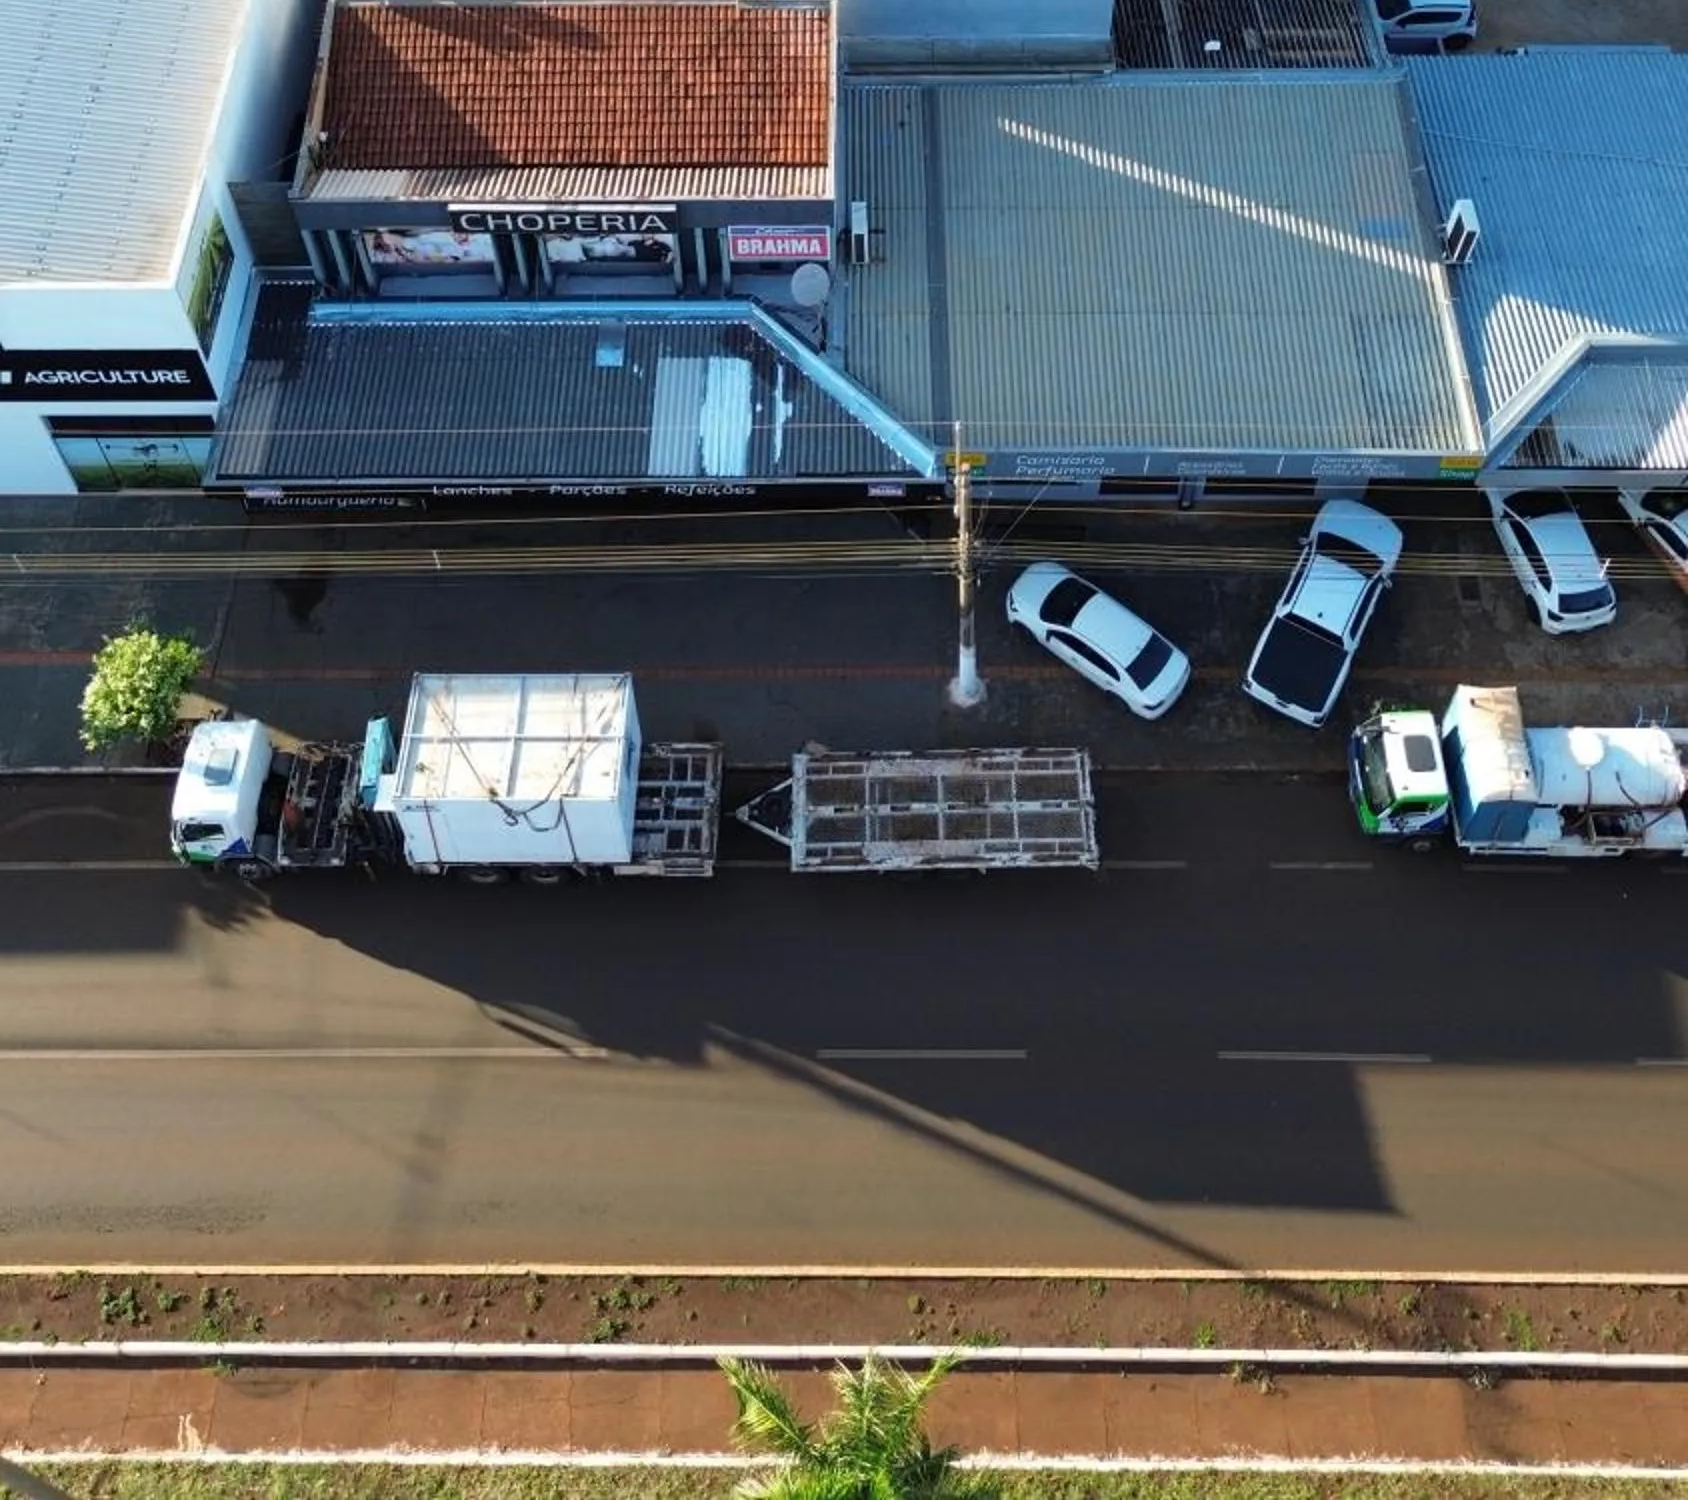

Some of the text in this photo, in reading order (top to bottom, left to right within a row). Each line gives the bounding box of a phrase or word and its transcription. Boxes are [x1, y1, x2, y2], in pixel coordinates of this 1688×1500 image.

[459, 212, 668, 231] CHOPERIA
[736, 238, 821, 255] BRAHMA
[24, 370, 191, 384] AGRICULTURE
[432, 484, 513, 496] Lanches
[663, 483, 757, 497] Refeições
